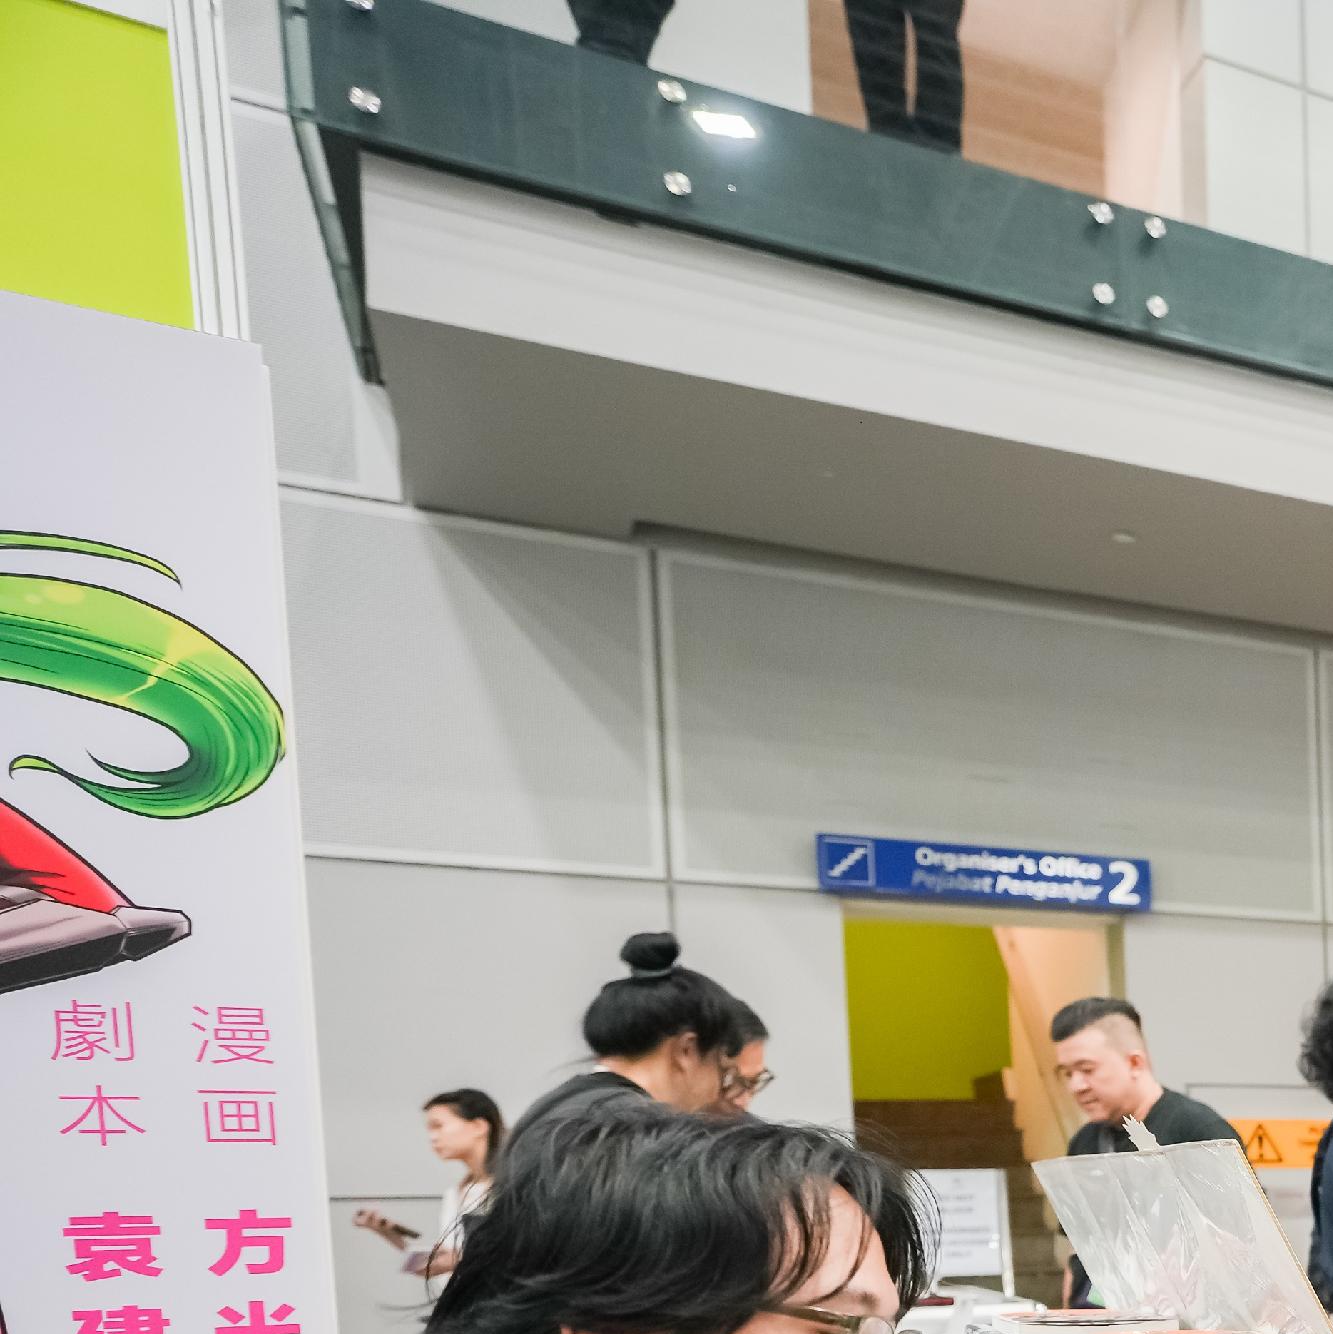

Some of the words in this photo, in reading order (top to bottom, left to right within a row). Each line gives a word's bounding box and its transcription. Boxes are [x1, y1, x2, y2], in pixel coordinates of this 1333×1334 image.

[915, 847, 1037, 876] Organiser's
[1038, 855, 1103, 881] Office
[1108, 860, 1142, 906] 2
[995, 874, 1103, 902] Penganjur
[50, 999, 147, 1147] 劇本
[191, 1004, 277, 1146] 漫画
